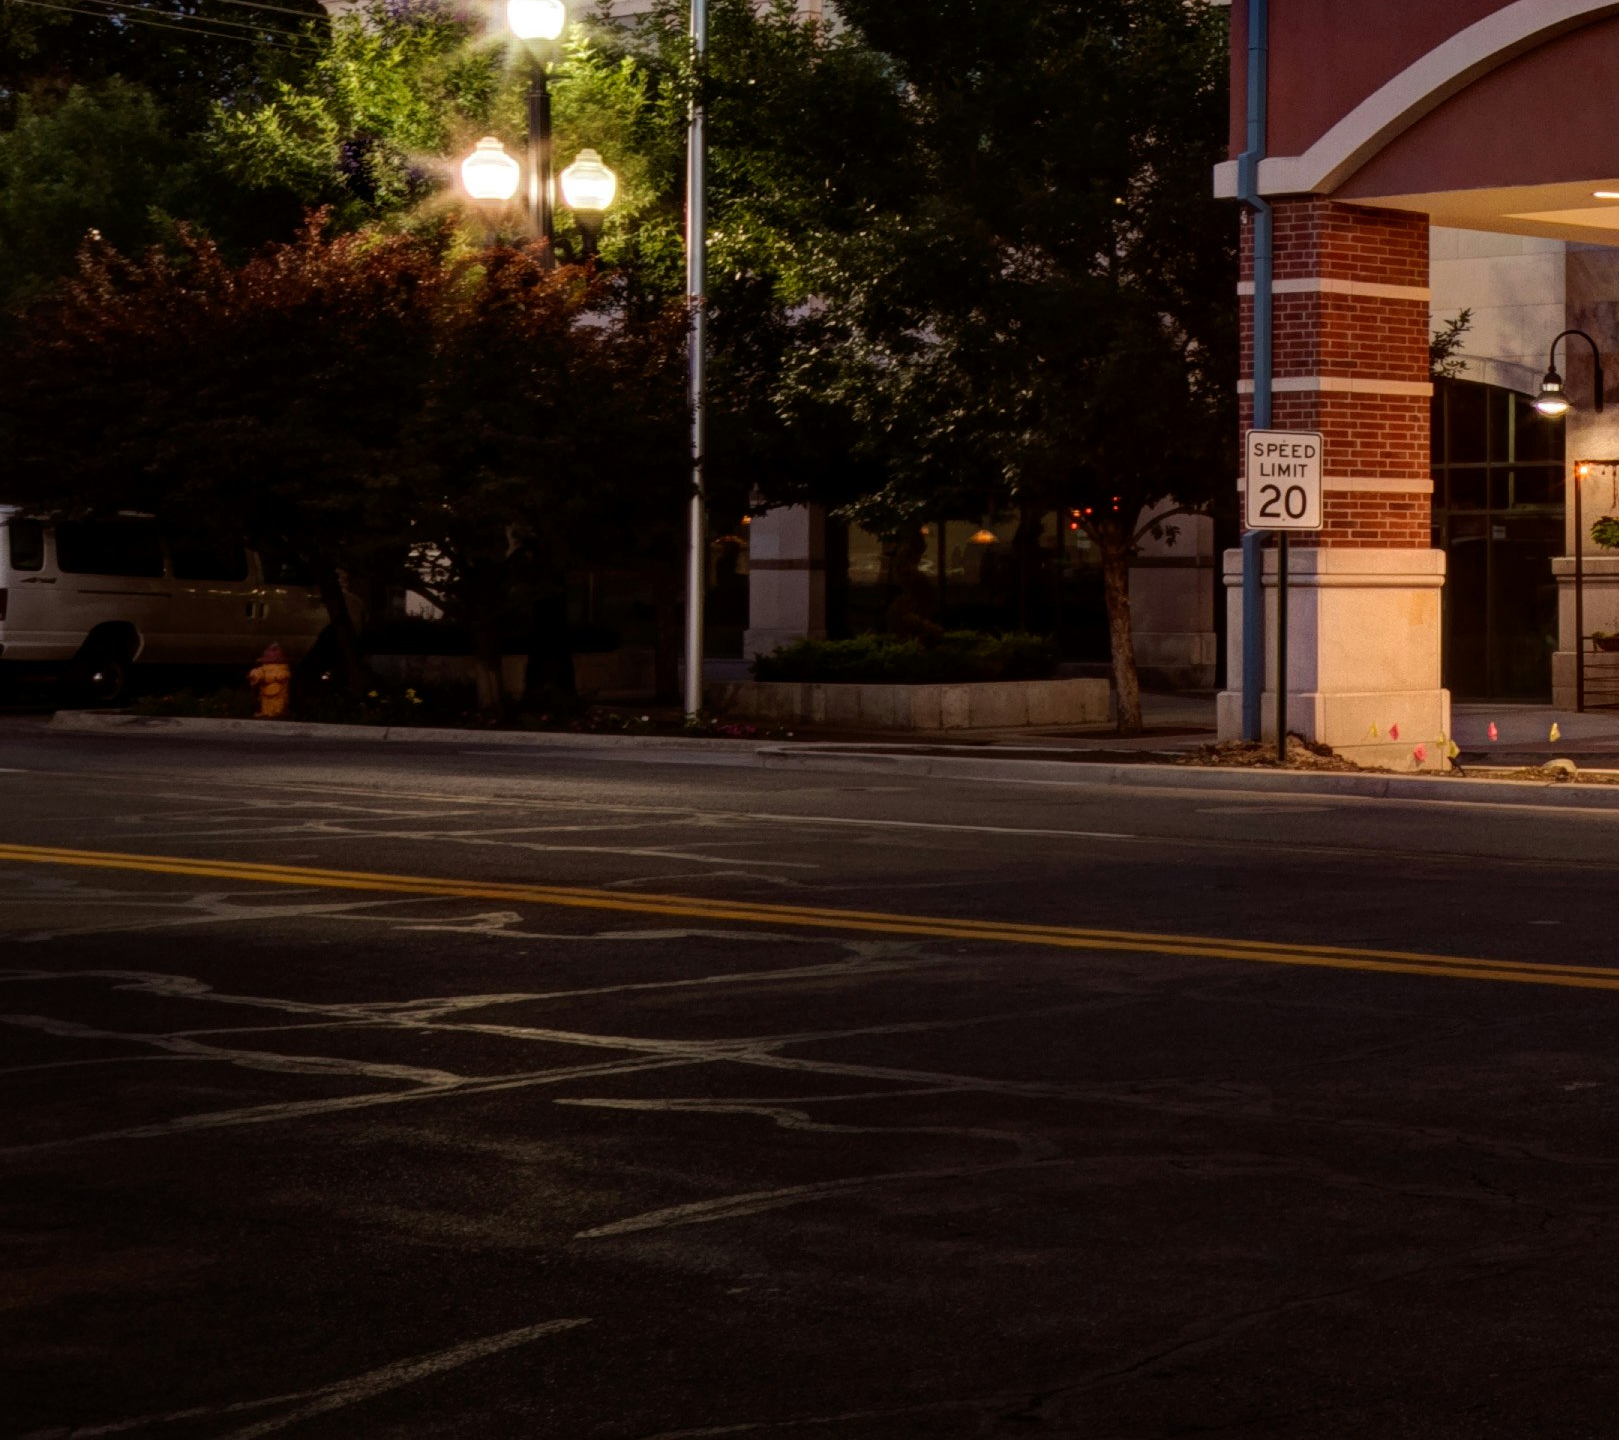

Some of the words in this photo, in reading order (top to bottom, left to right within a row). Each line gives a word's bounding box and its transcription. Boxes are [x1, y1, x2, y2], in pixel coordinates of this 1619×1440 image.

[1253, 442, 1316, 459] SPEED
[1260, 462, 1308, 478] LIMIT
[1259, 483, 1307, 520] 20
